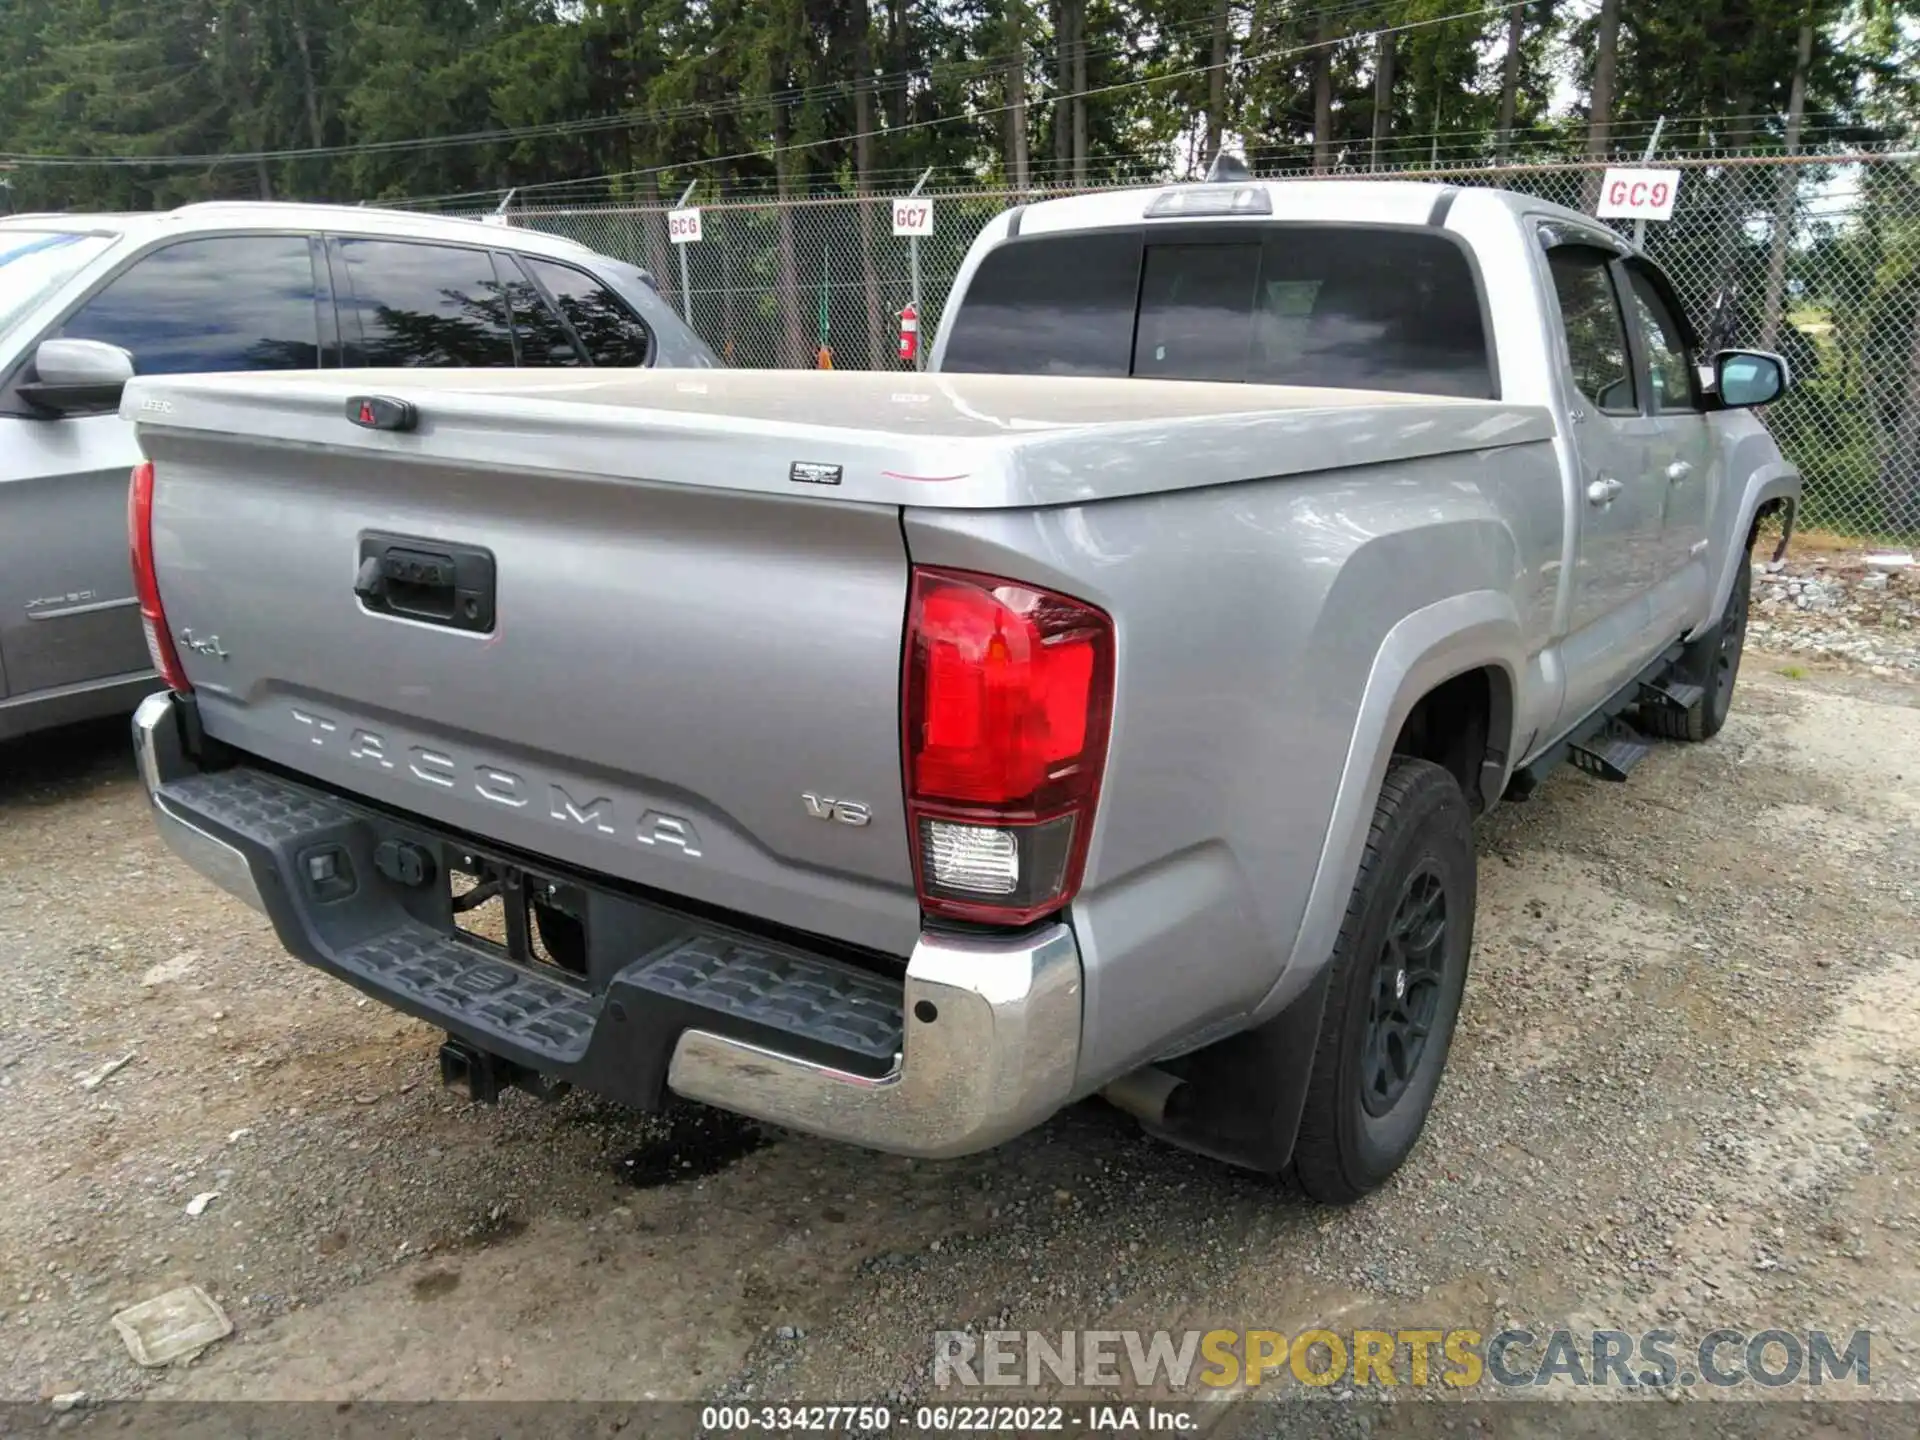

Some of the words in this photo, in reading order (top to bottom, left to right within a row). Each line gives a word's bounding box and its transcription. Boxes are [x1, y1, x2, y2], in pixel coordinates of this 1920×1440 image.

[1609, 181, 1668, 208] GC9
[896, 208, 927, 228] GC7
[292, 709, 702, 857] TACOMA
[801, 791, 872, 827] V6
